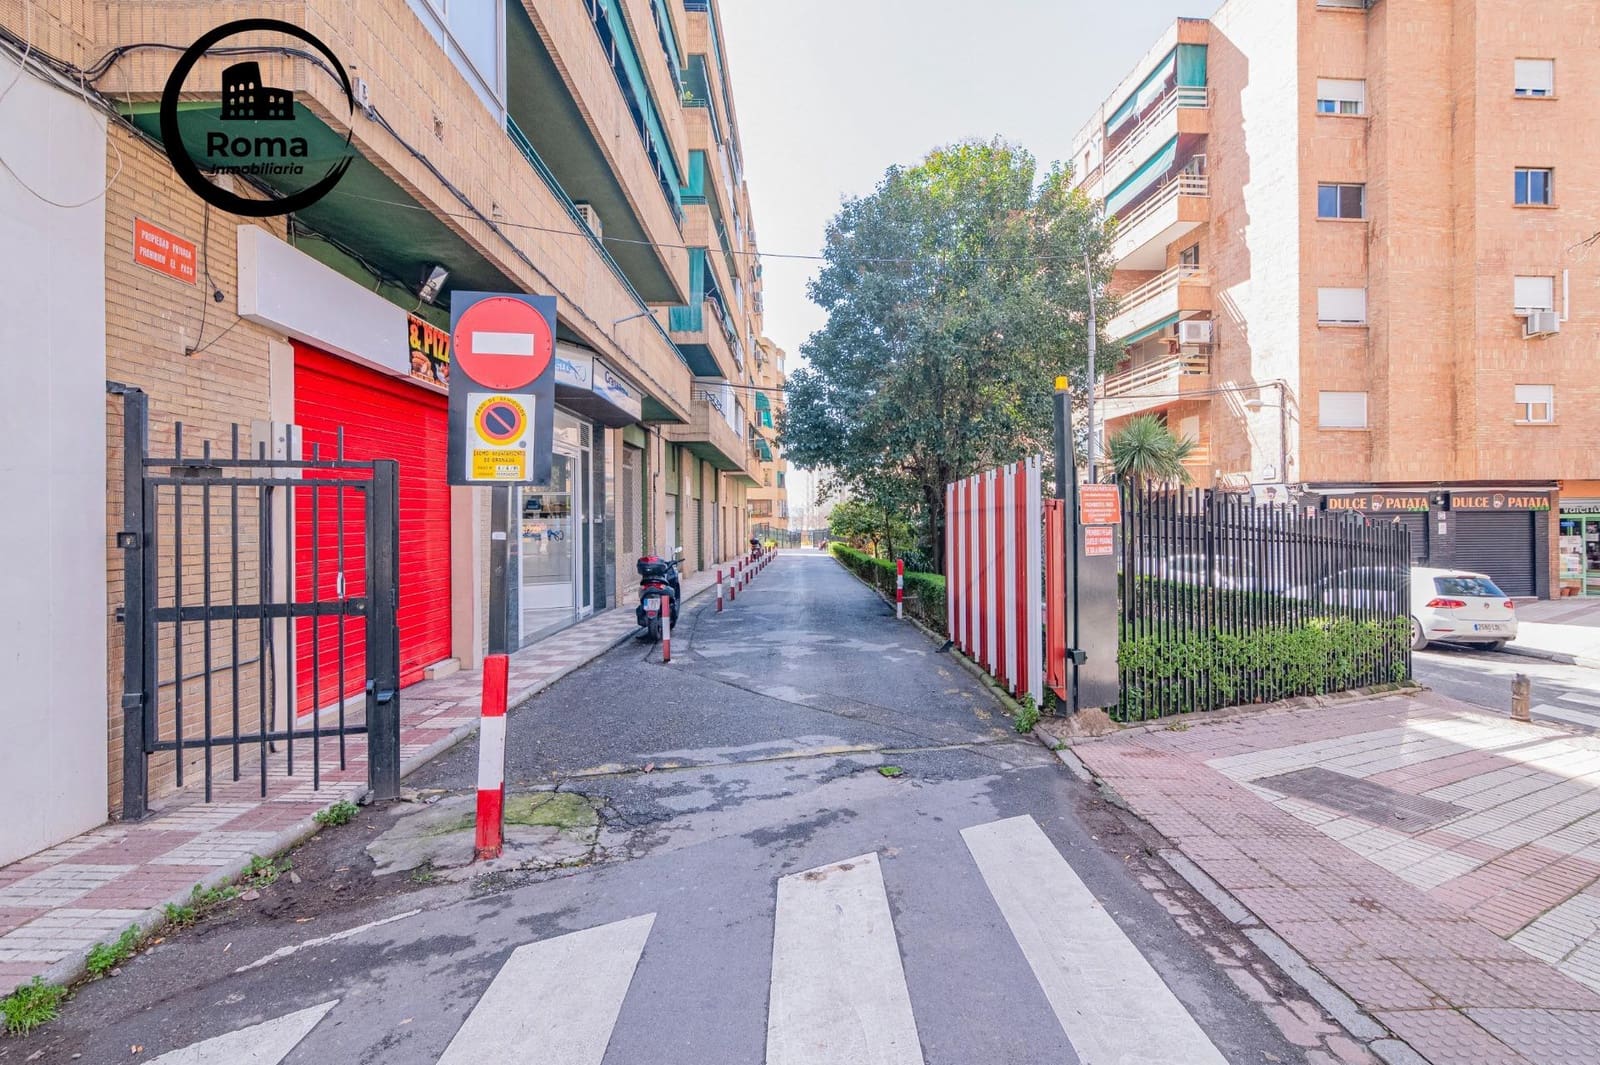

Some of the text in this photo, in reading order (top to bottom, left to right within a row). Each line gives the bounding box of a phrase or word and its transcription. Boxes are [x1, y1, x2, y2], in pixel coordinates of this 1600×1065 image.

[1329, 497, 1367, 509] DULCE
[1386, 497, 1429, 509] PATATA
[1452, 496, 1550, 508] DULCE PATATA
